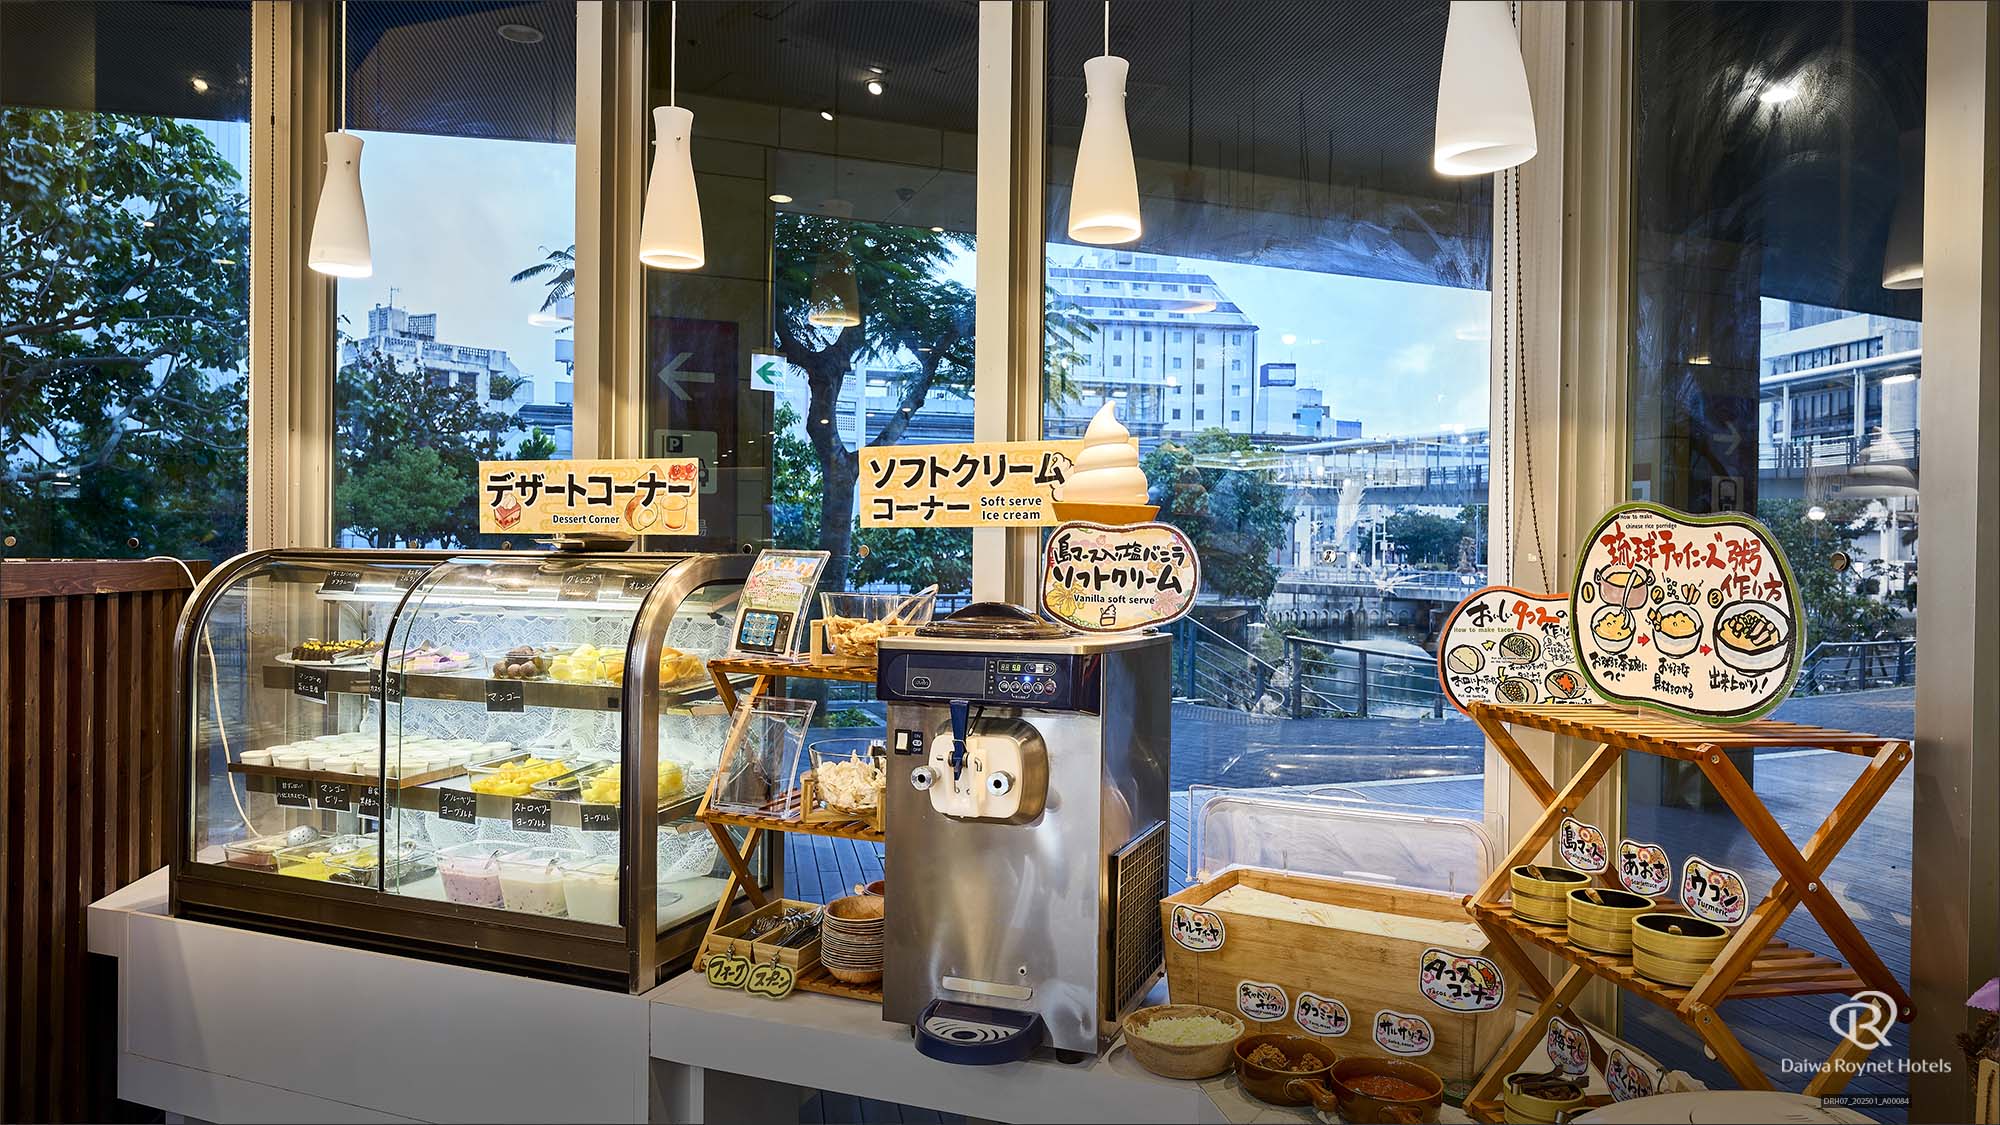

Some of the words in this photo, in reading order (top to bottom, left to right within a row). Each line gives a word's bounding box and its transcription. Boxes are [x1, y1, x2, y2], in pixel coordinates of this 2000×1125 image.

[869, 452, 1066, 489] ソフトクリーム
[486, 471, 691, 508] デザートコーナー
[872, 495, 970, 521] コーナー
[980, 496, 1002, 507] Soft
[1004, 497, 1043, 507] serve
[552, 515, 587, 525] Dessert
[588, 515, 620, 525] Corner
[982, 510, 1001, 520] Ice
[1003, 511, 1041, 520] cream
[1600, 523, 1763, 577] 琉球チャイニーズ粥
[1053, 564, 1183, 593] ソフトクリーム
[1719, 574, 1783, 602] 作り方
[1074, 593, 1106, 604] Vanilla
[1107, 594, 1127, 604] soft
[1129, 596, 1155, 605] serve
[1603, 670, 1626, 682] つぐ
[1658, 657, 1690, 678] お好きな
[487, 691, 521, 701] マンゴー
[1464, 685, 1489, 694] のせる
[1652, 674, 1694, 699] 具材をのせる
[320, 784, 345, 793] マンゴー
[443, 793, 476, 804] ブルーベリー
[441, 806, 473, 819] ヨーグルト
[513, 802, 551, 815] ストロベリー
[583, 813, 611, 823] ヨーグルト
[516, 817, 546, 828] ヨーグルト
[1563, 826, 1605, 861] 島マース
[1623, 851, 1665, 879] あおさ
[1691, 868, 1738, 907] ウコン
[1697, 898, 1728, 916] Turmeric
[710, 960, 745, 982] フォーク
[754, 970, 790, 988] スプーン
[1424, 958, 1475, 983] タコス
[1447, 983, 1495, 1004] コーナー
[1300, 1001, 1346, 1027] タコミート
[1380, 1020, 1429, 1042] サルサソース
